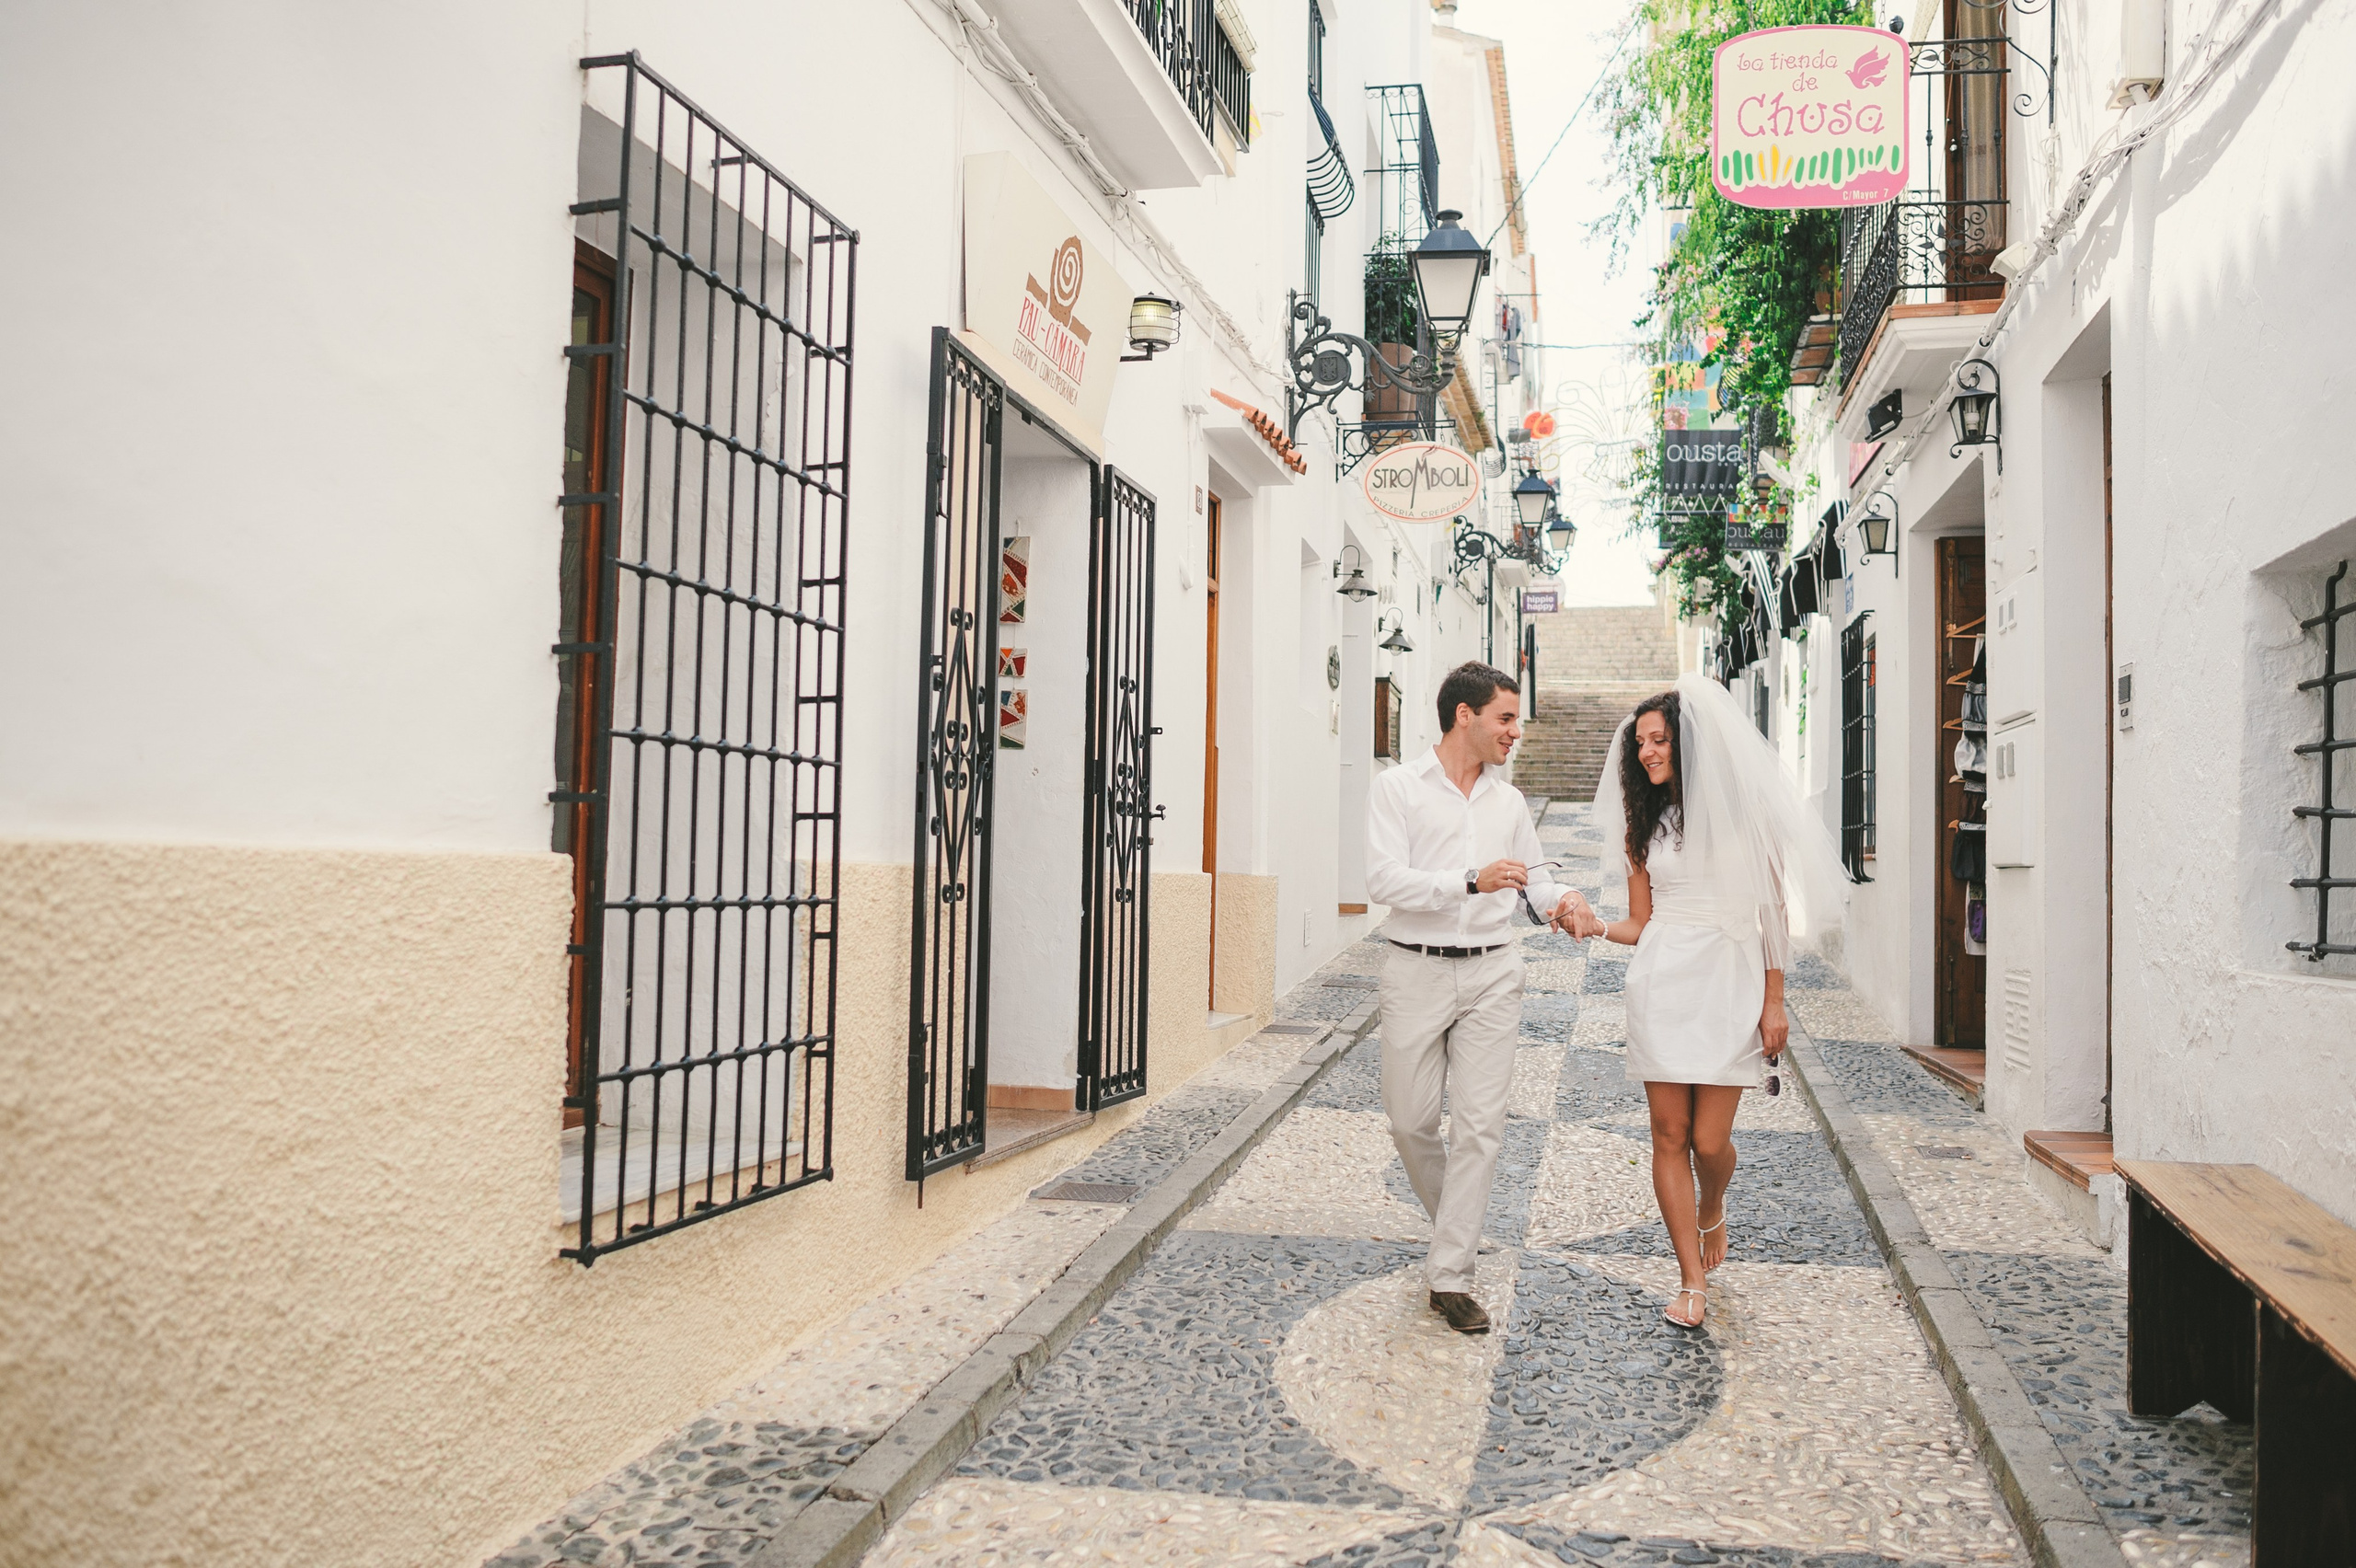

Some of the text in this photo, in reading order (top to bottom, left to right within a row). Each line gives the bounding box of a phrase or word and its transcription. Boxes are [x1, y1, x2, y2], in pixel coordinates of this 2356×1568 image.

[1737, 49, 1839, 71] La tienda
[1792, 72, 1819, 92] de
[1738, 91, 1885, 137] Chusa
[1842, 188, 1889, 201] C/Mayor 7
[1012, 338, 1039, 374] CERÁMICA
[1667, 442, 1744, 462] ousta
[1373, 496, 1469, 518] PIZZERIA CREPERIA
[1527, 603, 1554, 612] happy
